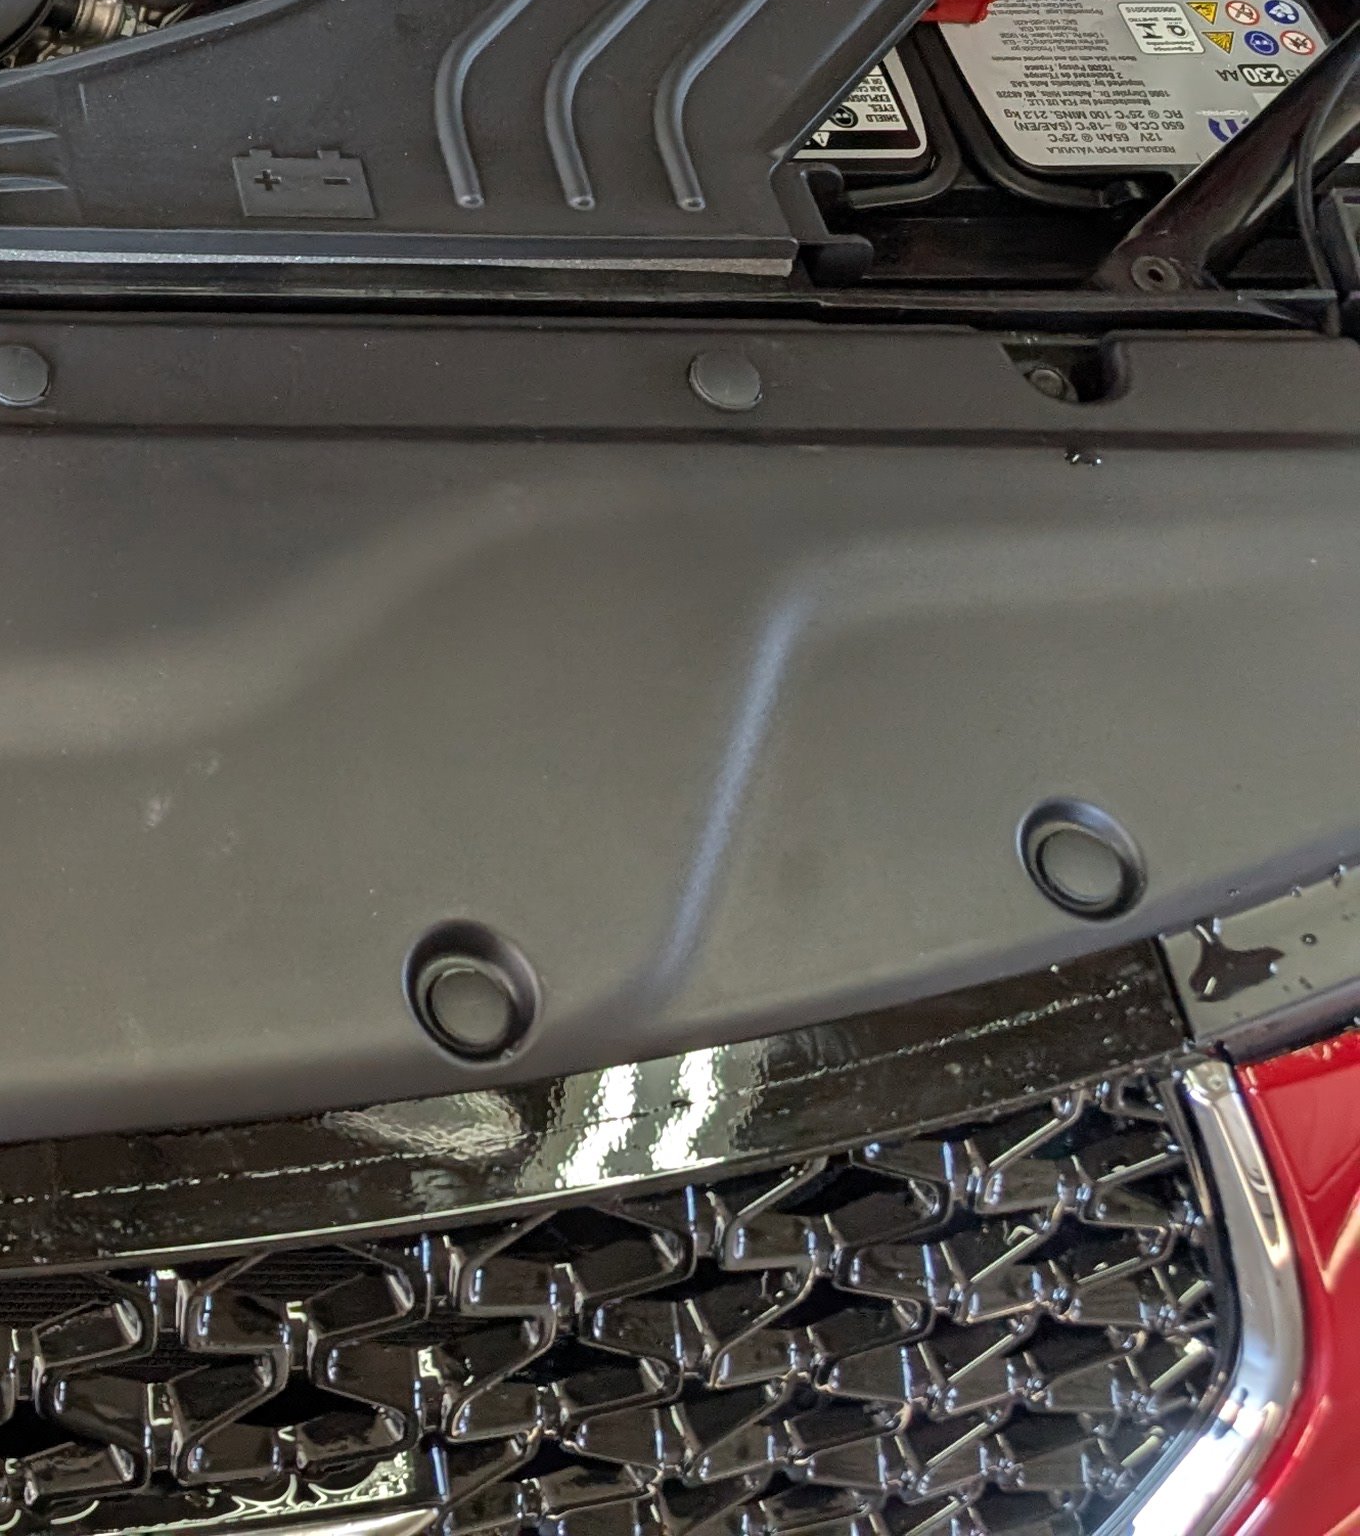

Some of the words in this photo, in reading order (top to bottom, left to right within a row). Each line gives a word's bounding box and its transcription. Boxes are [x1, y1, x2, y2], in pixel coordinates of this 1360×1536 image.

[1216, 69, 1239, 82] AA
[1242, 67, 1286, 83] 230
[865, 114, 900, 122] SHIELD
[1003, 108, 1022, 119] kg
[1054, 110, 1088, 120] MINS.
[1091, 110, 1112, 119] 100
[1147, 110, 1160, 120] @
[1164, 110, 1184, 119] RC
[1014, 121, 1073, 132] (SAE/EN)
[1115, 121, 1127, 131] @
[1132, 121, 1160, 131] CCA
[1164, 121, 1185, 131] 650
[1047, 133, 1078, 142] 25°C
[1081, 133, 1093, 143] @
[1096, 133, 1130, 142] 65Ah
[1140, 133, 1163, 142] 12V
[1097, 146, 1120, 154] POR
[1121, 146, 1176, 154] REGULADA
